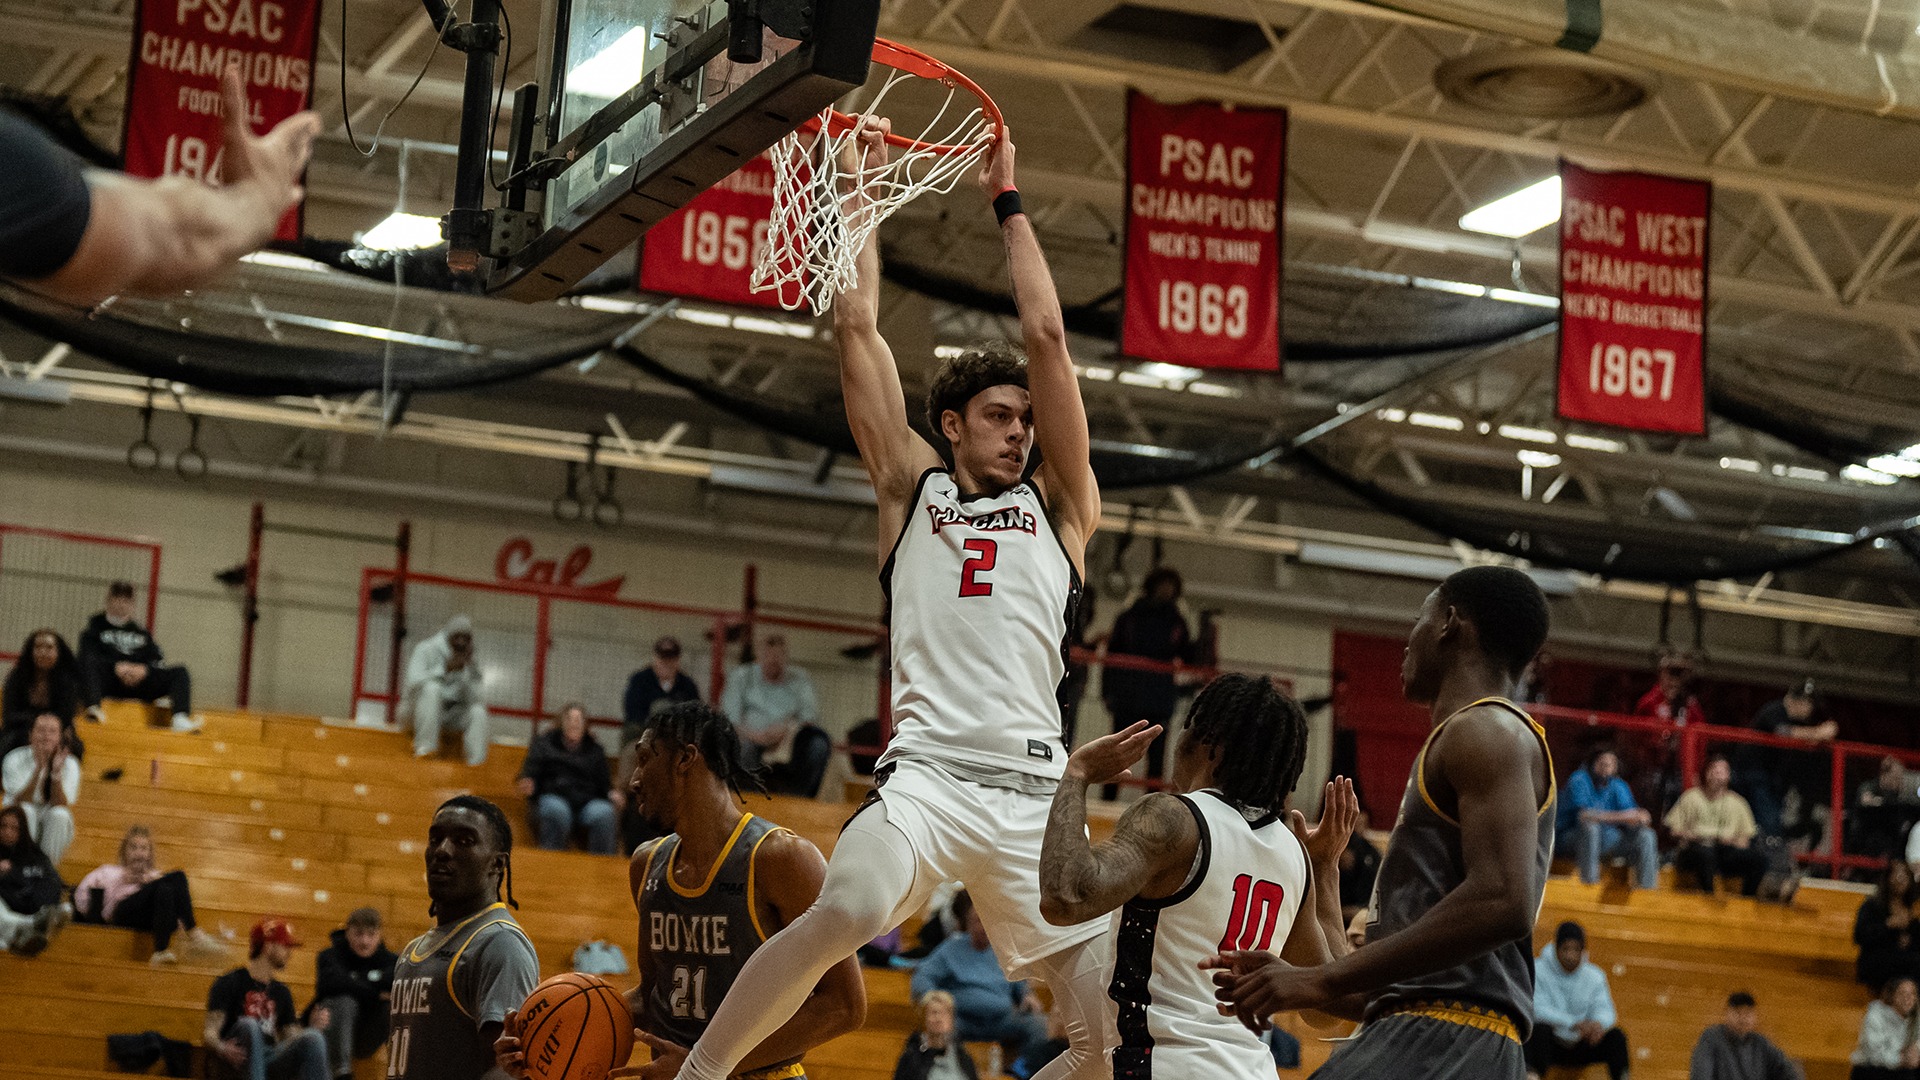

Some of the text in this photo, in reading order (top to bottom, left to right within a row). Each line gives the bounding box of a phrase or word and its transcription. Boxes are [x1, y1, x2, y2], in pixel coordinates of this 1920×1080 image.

[176, 0, 284, 42] PSAC
[141, 31, 310, 92] CHAMPIONS
[178, 86, 265, 125] FOOTL
[1160, 134, 1254, 189] PSAC
[1132, 183, 1277, 233] CHAMPIONS
[1562, 197, 1705, 257] PSAC WEST
[1149, 231, 1261, 267] MEN'S TENNIS
[1562, 249, 1703, 300] CHAMPIONS
[1158, 279, 1249, 340] 1963
[1562, 291, 1703, 336] MEN'S BASKETBALL
[1589, 342, 1676, 402] 1967
[494, 536, 626, 600] Cal
[958, 538, 999, 598] 2
[650, 911, 731, 955] BOWIE
[1217, 873, 1284, 954] 10
[390, 977, 432, 1015] OWIE
[669, 965, 708, 1021] 21
[387, 1026, 410, 1078] 10
